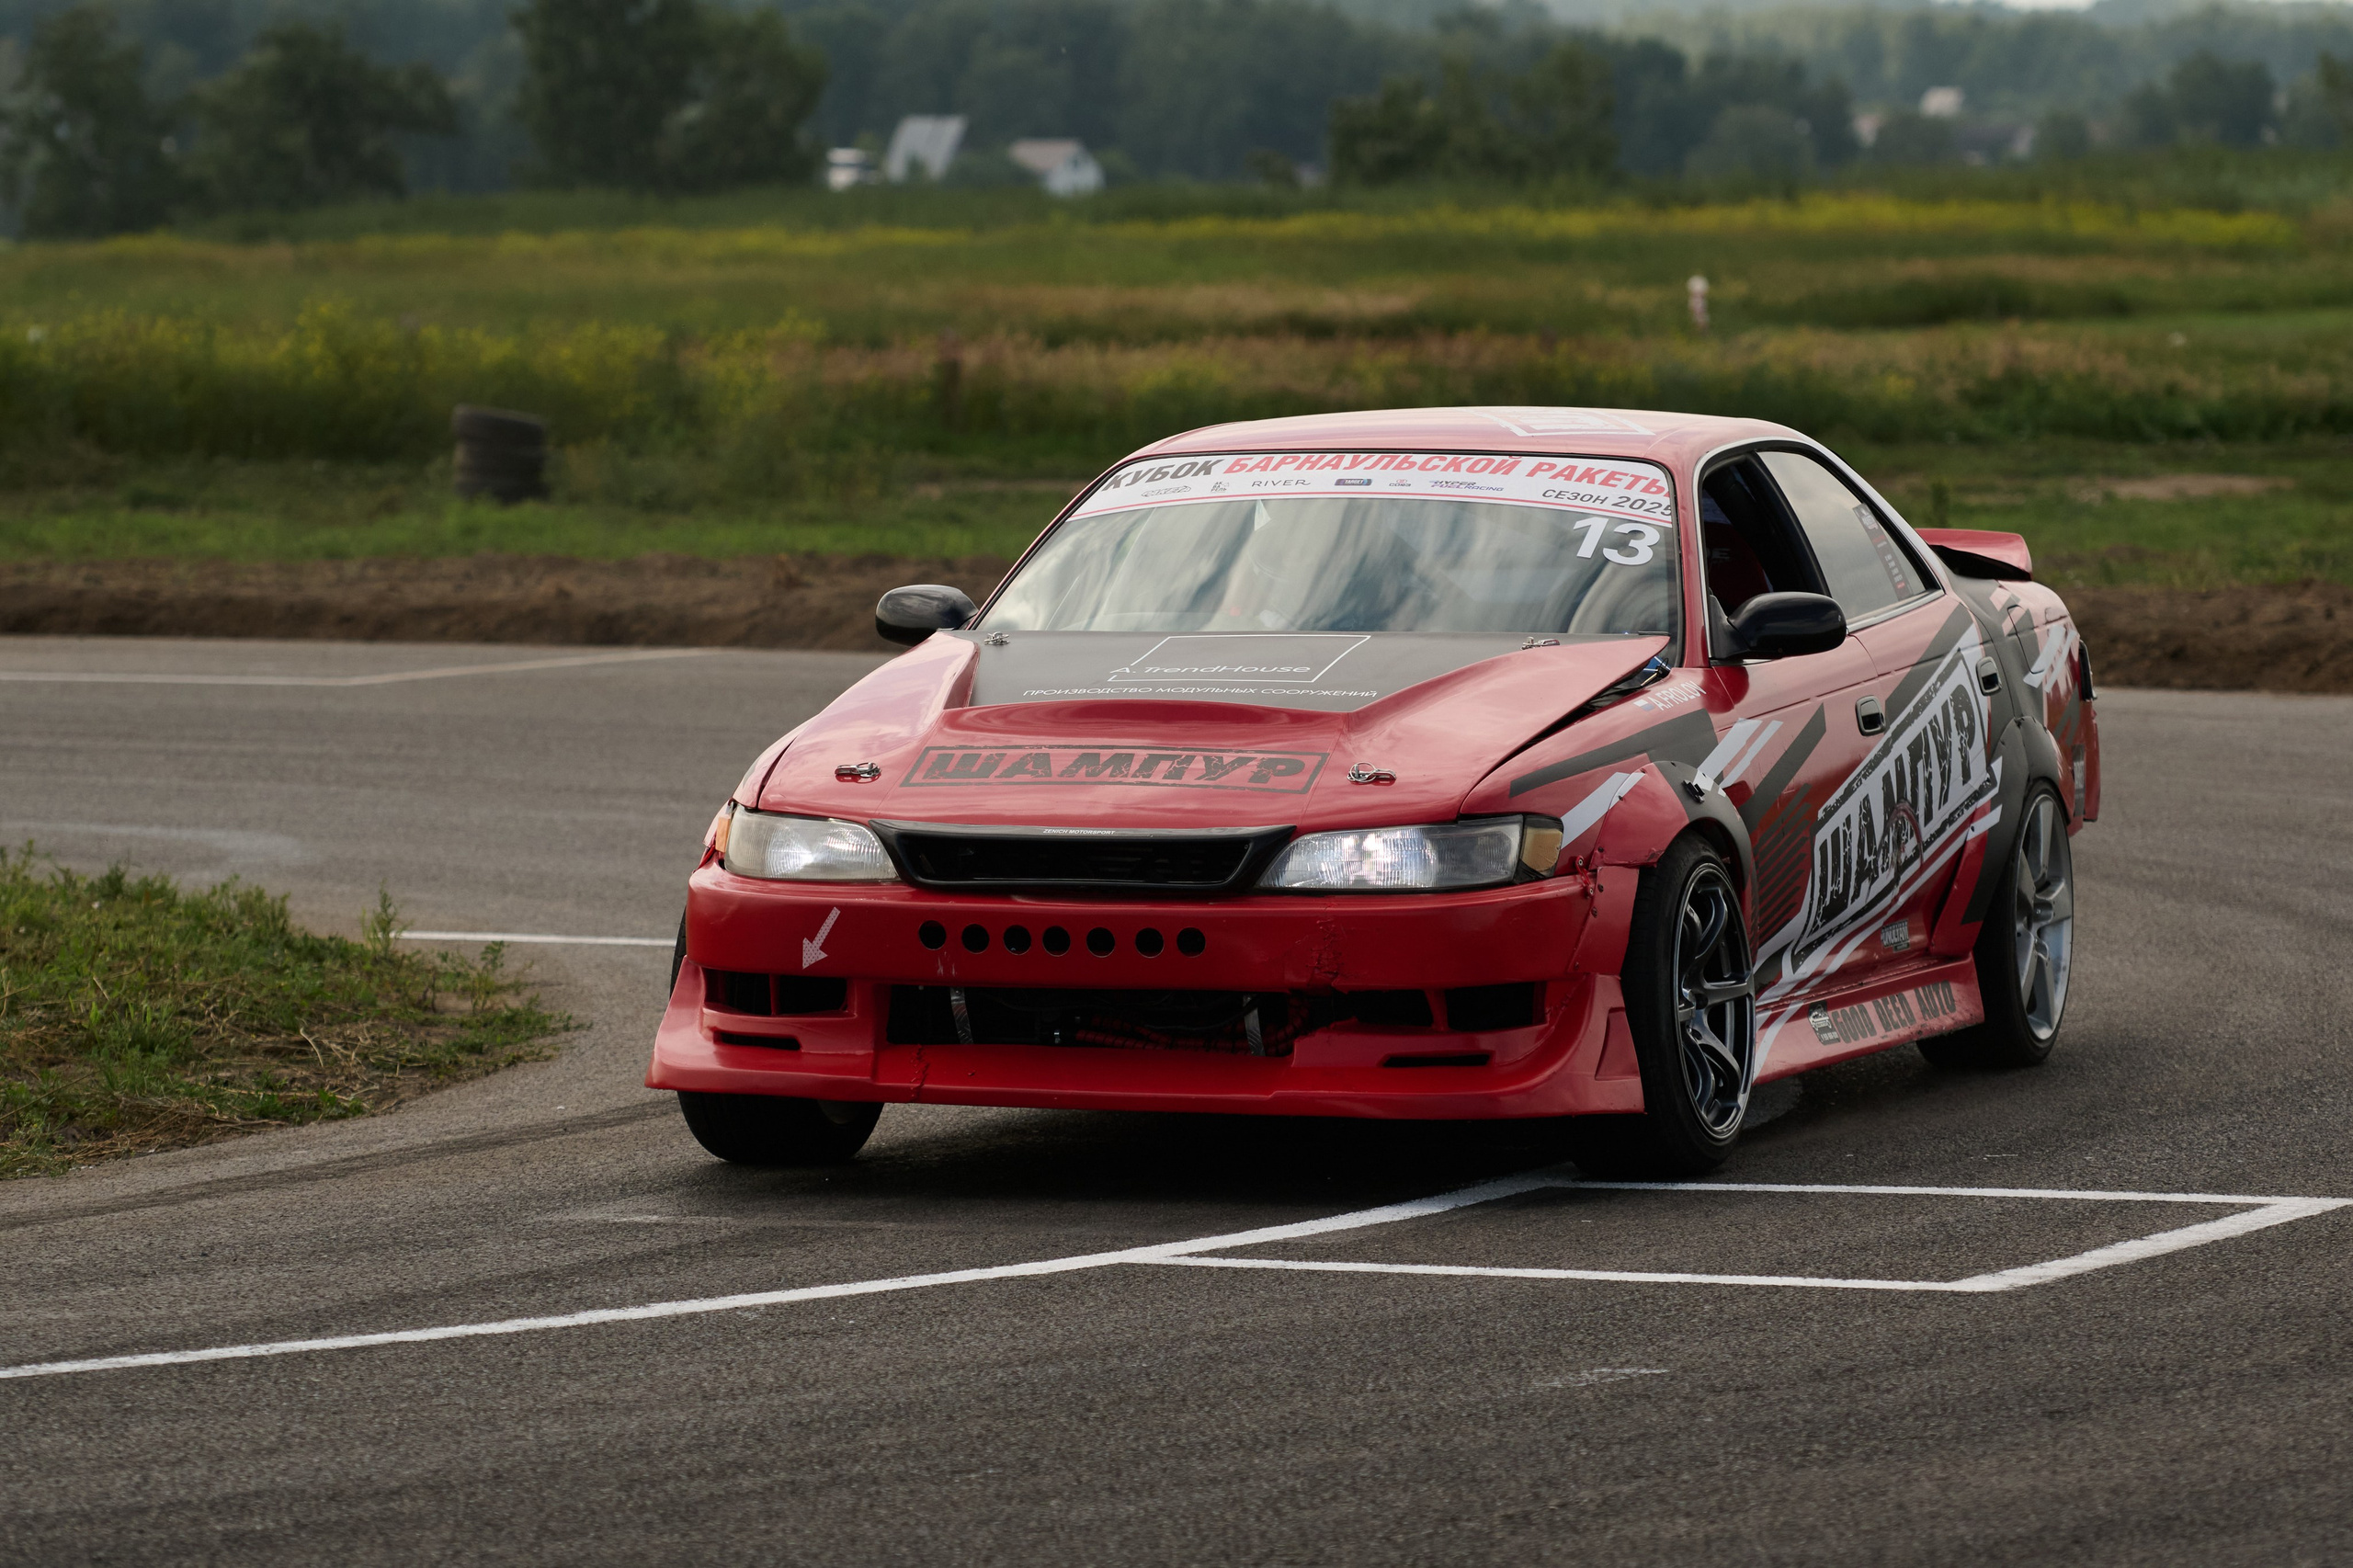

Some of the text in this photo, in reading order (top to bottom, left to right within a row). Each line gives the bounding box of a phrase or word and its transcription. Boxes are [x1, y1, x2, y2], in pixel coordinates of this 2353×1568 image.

[1101, 459, 1224, 492] КУБОК
[1223, 455, 1522, 476] БАРНАУЛЬСКОЙ
[1251, 479, 1311, 487] RIVER
[1541, 489, 1672, 517] СЕЗОН 2025
[1573, 517, 1660, 566] 13
[1023, 687, 1152, 697] ПРОИЗВОДСТВО
[1261, 688, 1378, 699] СООРУЖЕНИЙ
[922, 752, 1306, 785] ШАМПУР
[1814, 684, 1976, 926] ШАМПУР
[1832, 1004, 1877, 1044] GOOD
[1915, 980, 1956, 1021] AUTO
